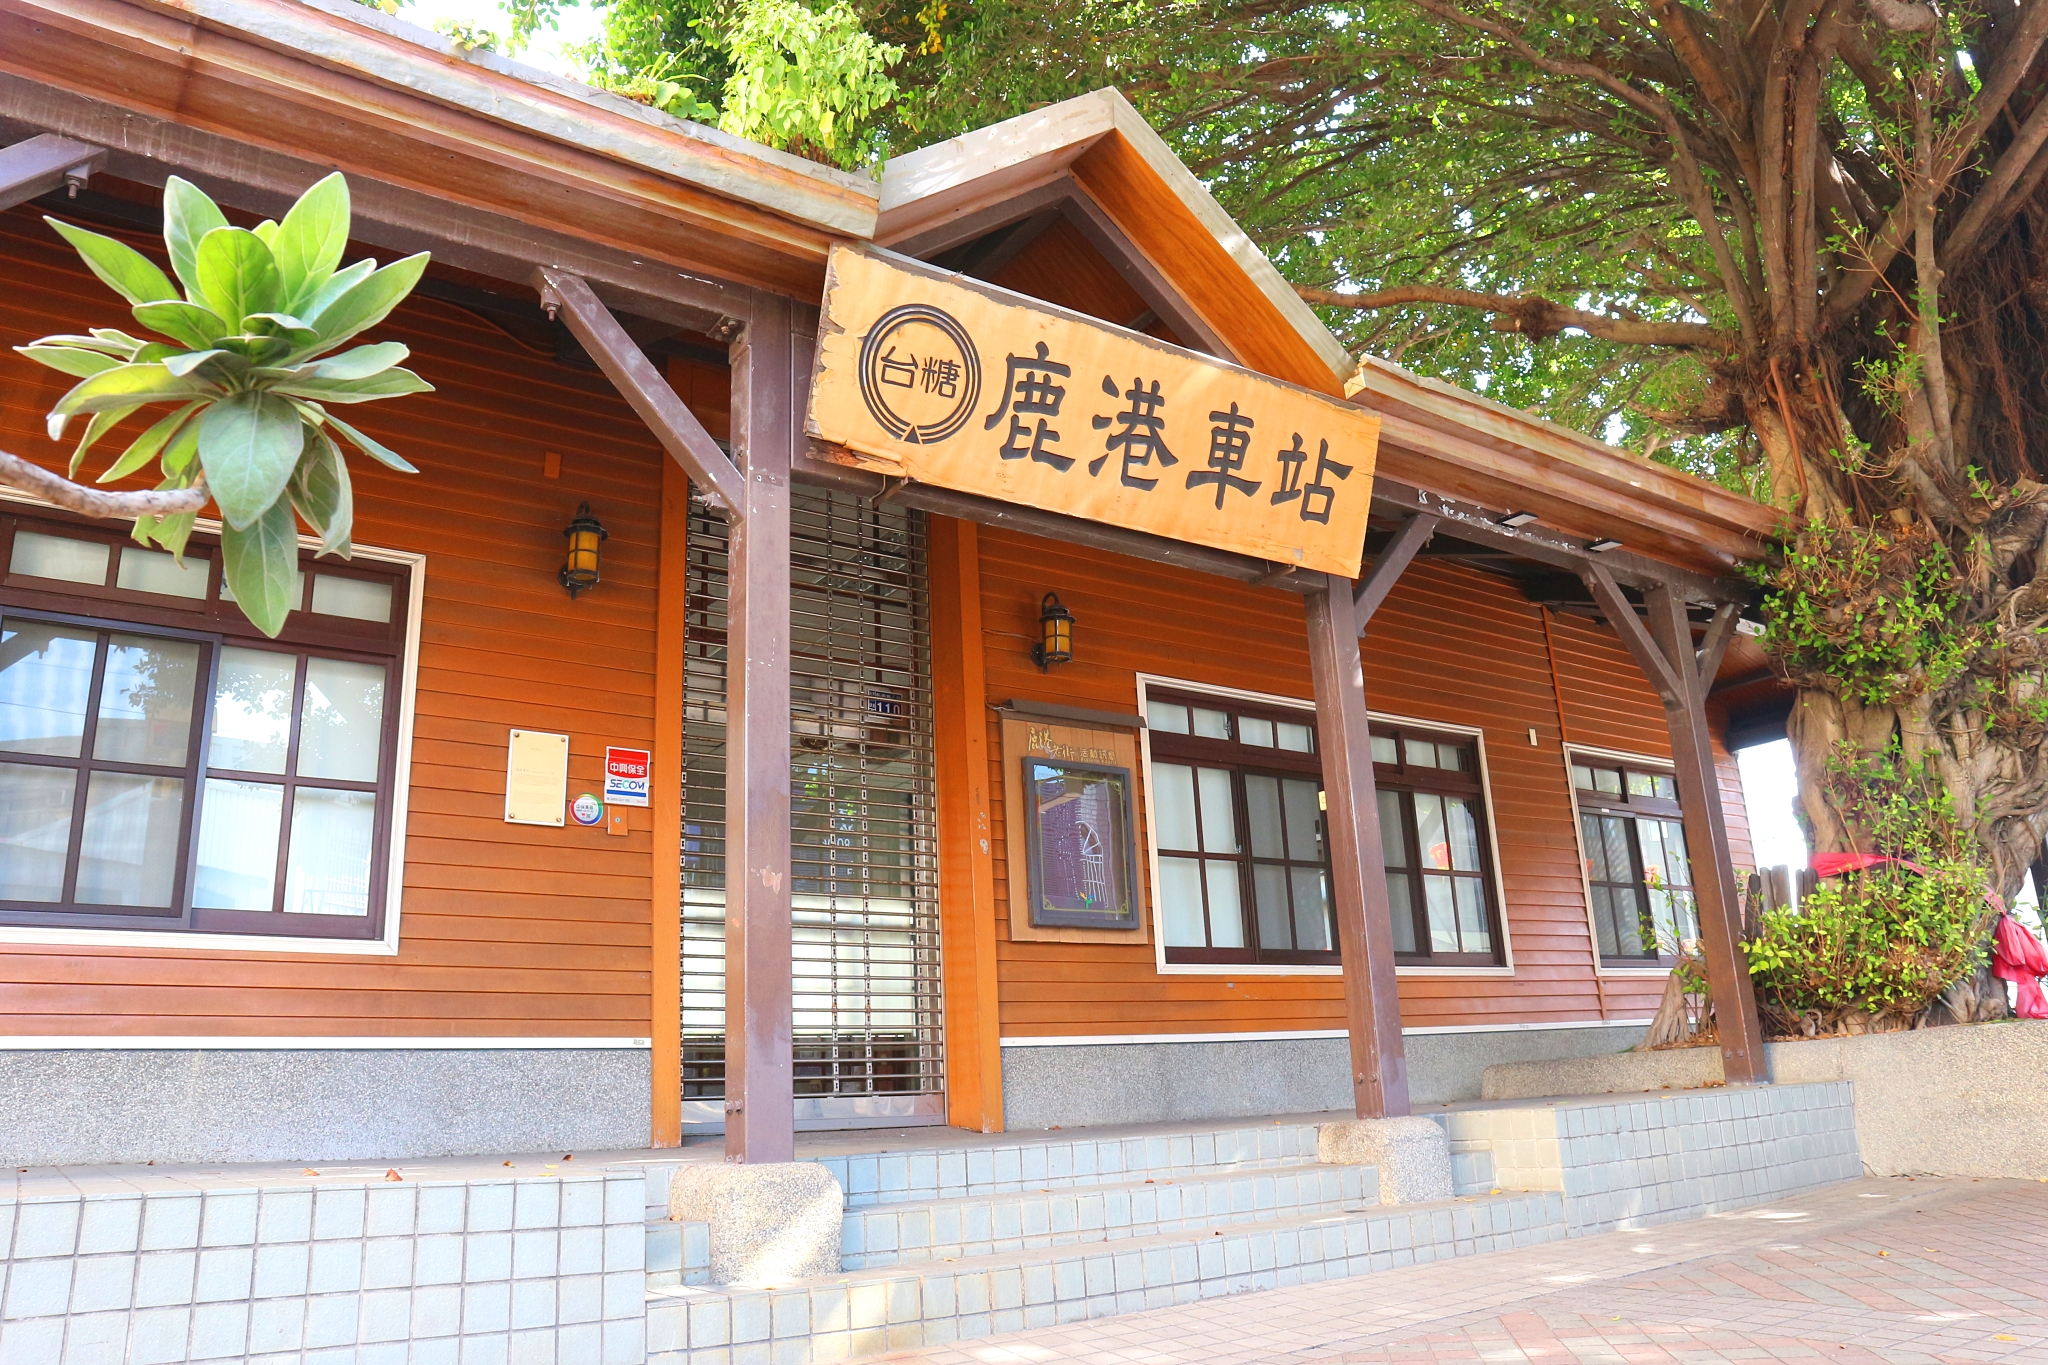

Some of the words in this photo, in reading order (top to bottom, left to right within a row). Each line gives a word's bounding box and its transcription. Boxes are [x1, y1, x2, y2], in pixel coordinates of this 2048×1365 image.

[881, 344, 962, 398] 台糖
[984, 341, 1354, 525] 鹿港車站
[610, 762, 645, 775] 中興保全
[610, 779, 645, 790] SECOM
